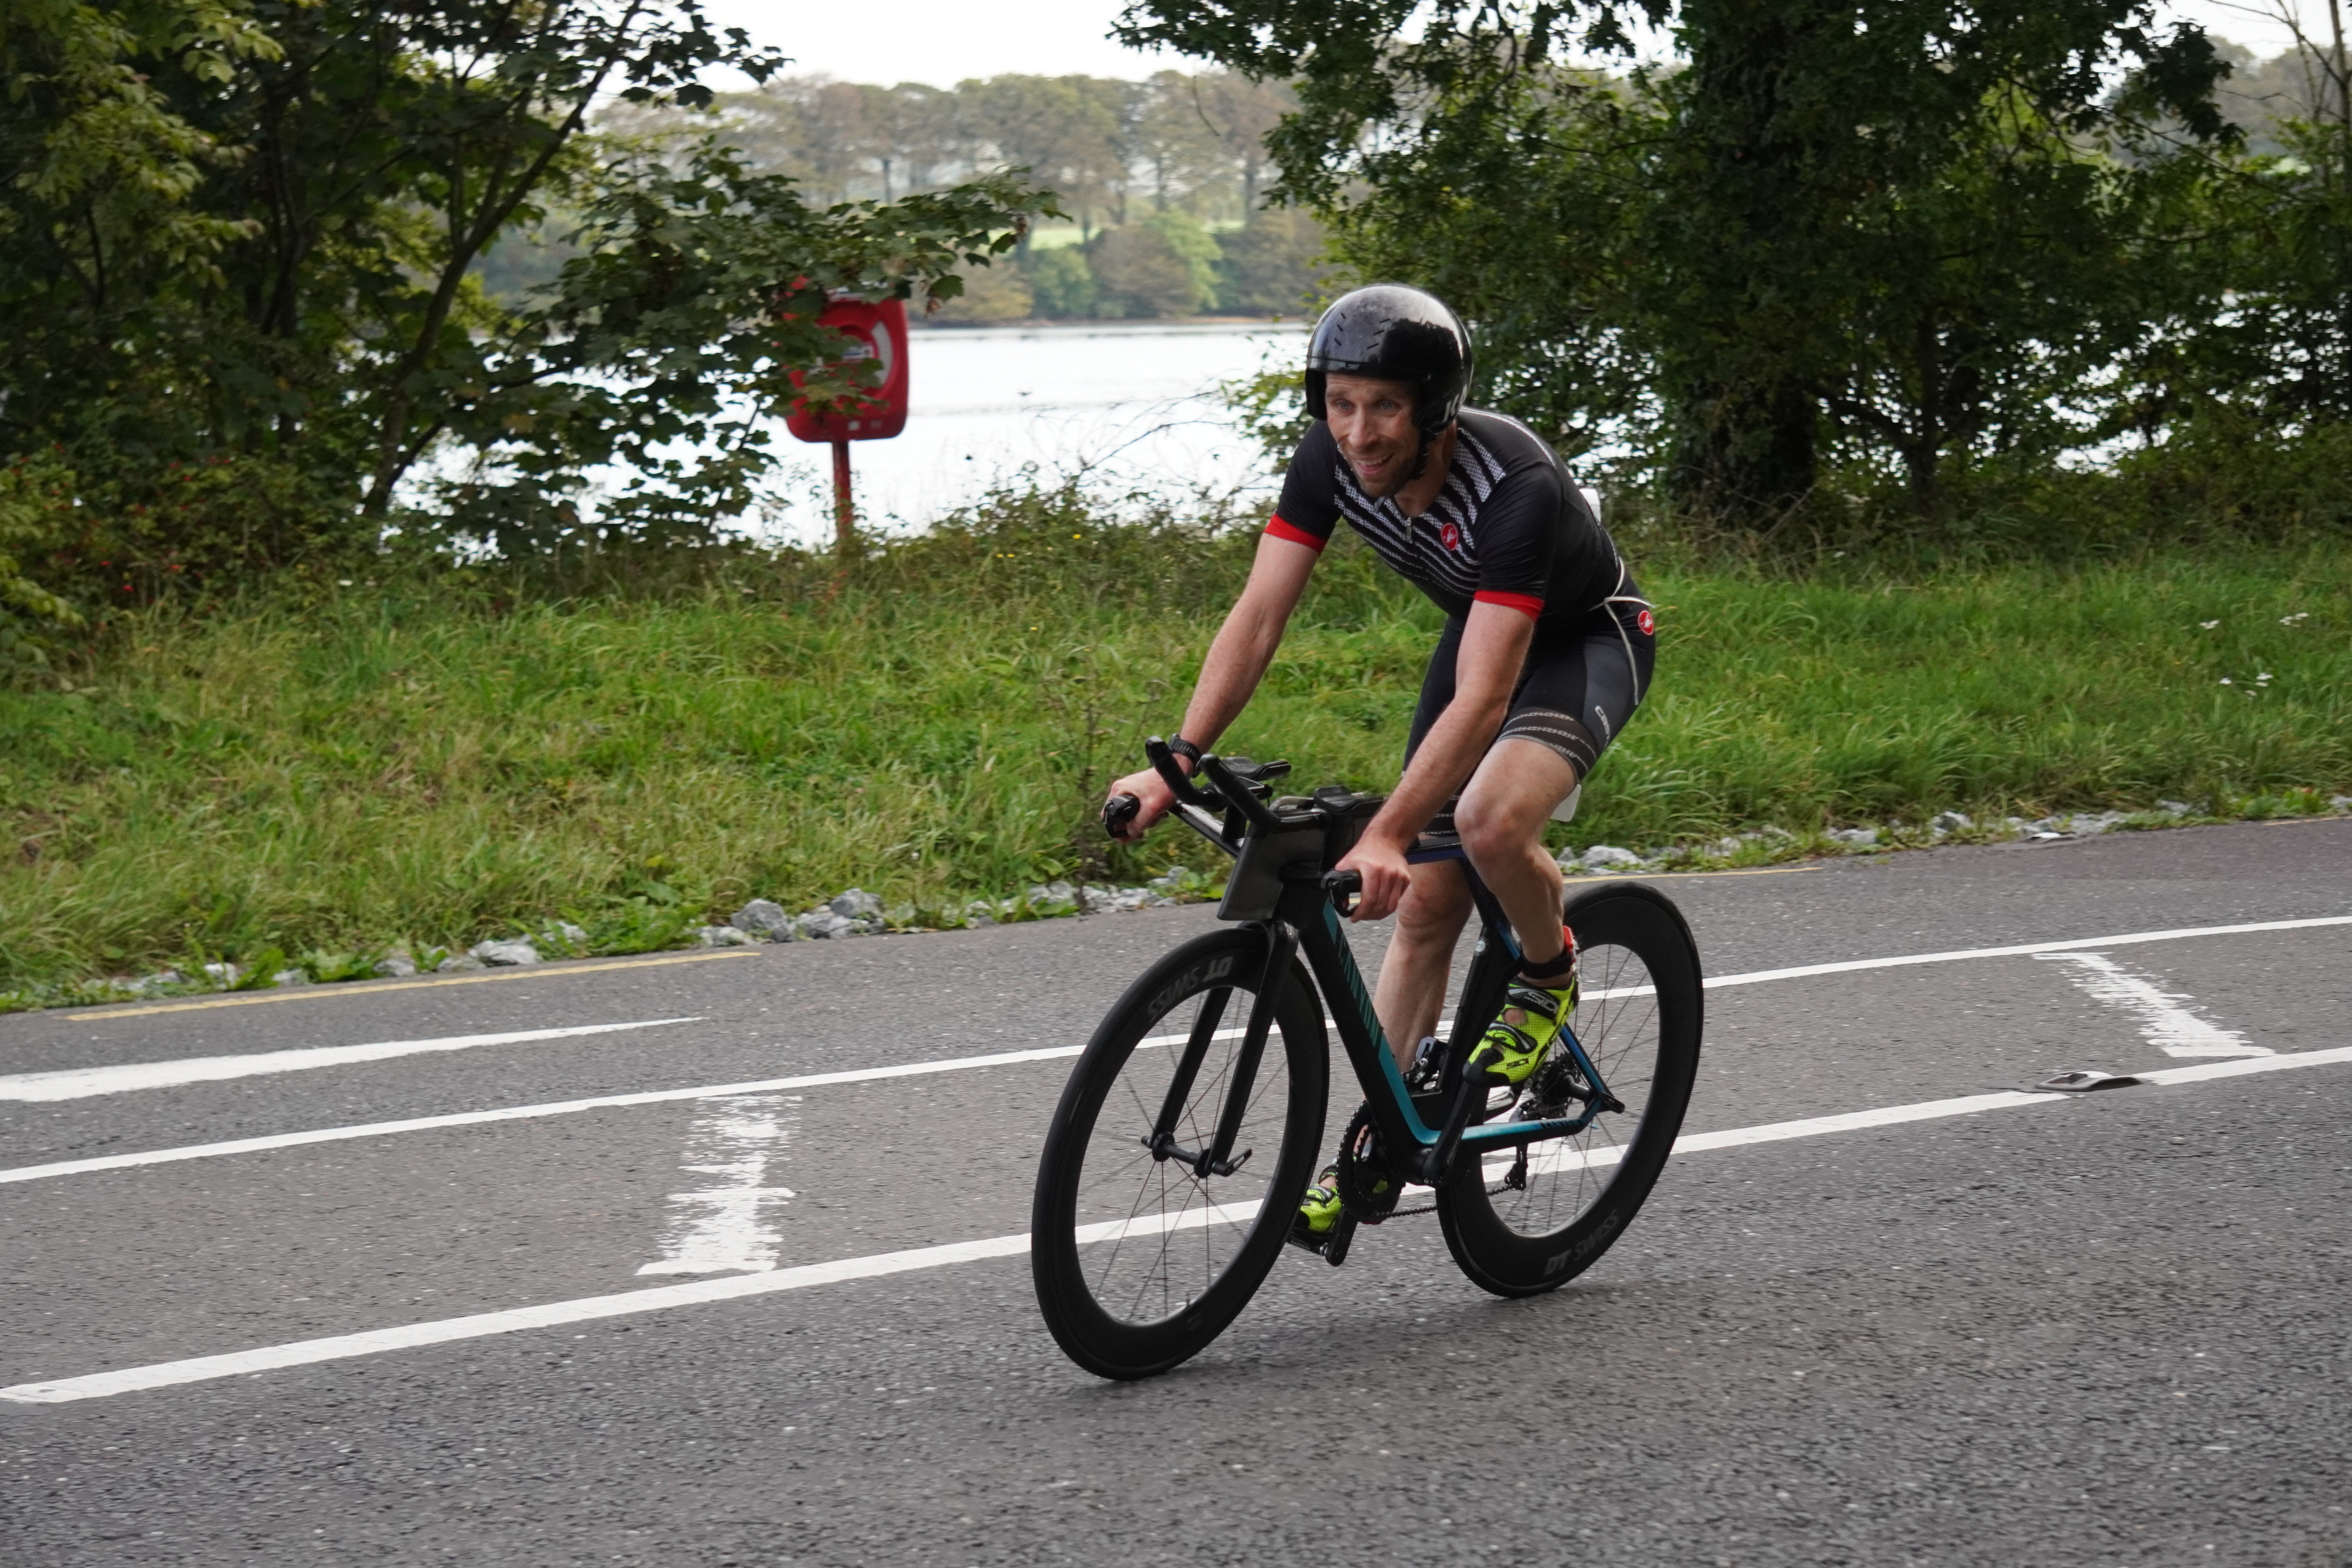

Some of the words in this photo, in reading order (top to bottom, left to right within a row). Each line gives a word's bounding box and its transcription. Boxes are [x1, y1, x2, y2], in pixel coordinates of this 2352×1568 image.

[1206, 956, 1233, 981] DT
[1290, 1240, 1310, 1250] GARMIN
[1543, 1249, 1571, 1276] DT
